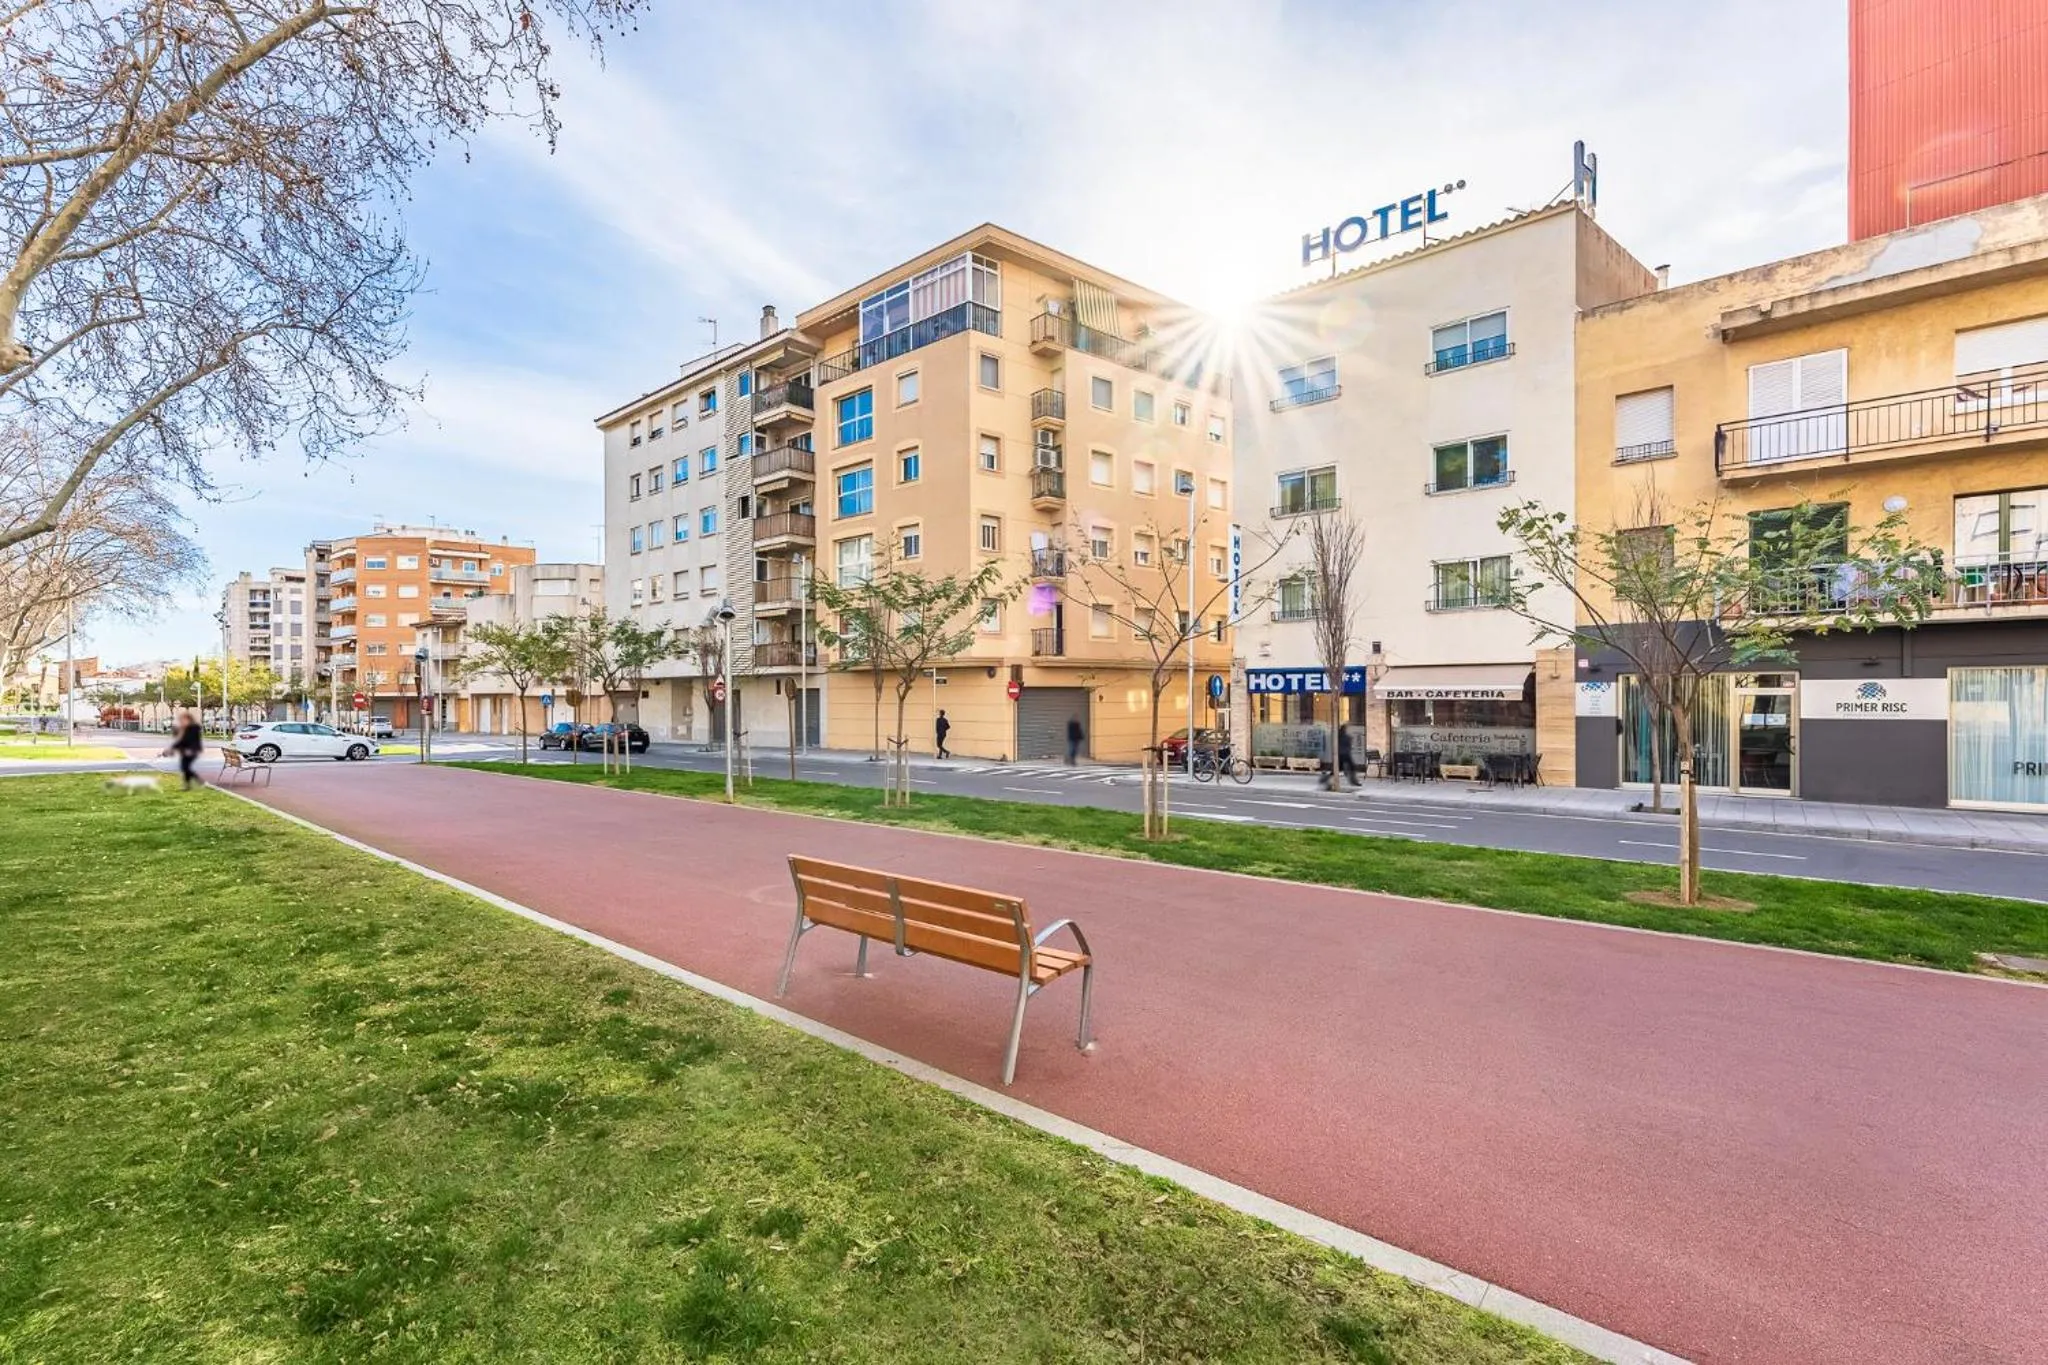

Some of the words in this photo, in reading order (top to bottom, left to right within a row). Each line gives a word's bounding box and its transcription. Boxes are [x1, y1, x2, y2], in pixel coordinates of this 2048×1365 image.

[1302, 188, 1449, 267] HOTEL
[1233, 535, 1241, 615] HOTEL
[1386, 690, 1414, 698] BAR
[1425, 689, 1506, 698] CAFETERIA
[1835, 702, 1878, 712] PRIMER
[1881, 702, 1908, 713] RISC
[1430, 732, 1491, 743] Cafeteria
[2013, 761, 2048, 776] PRI
